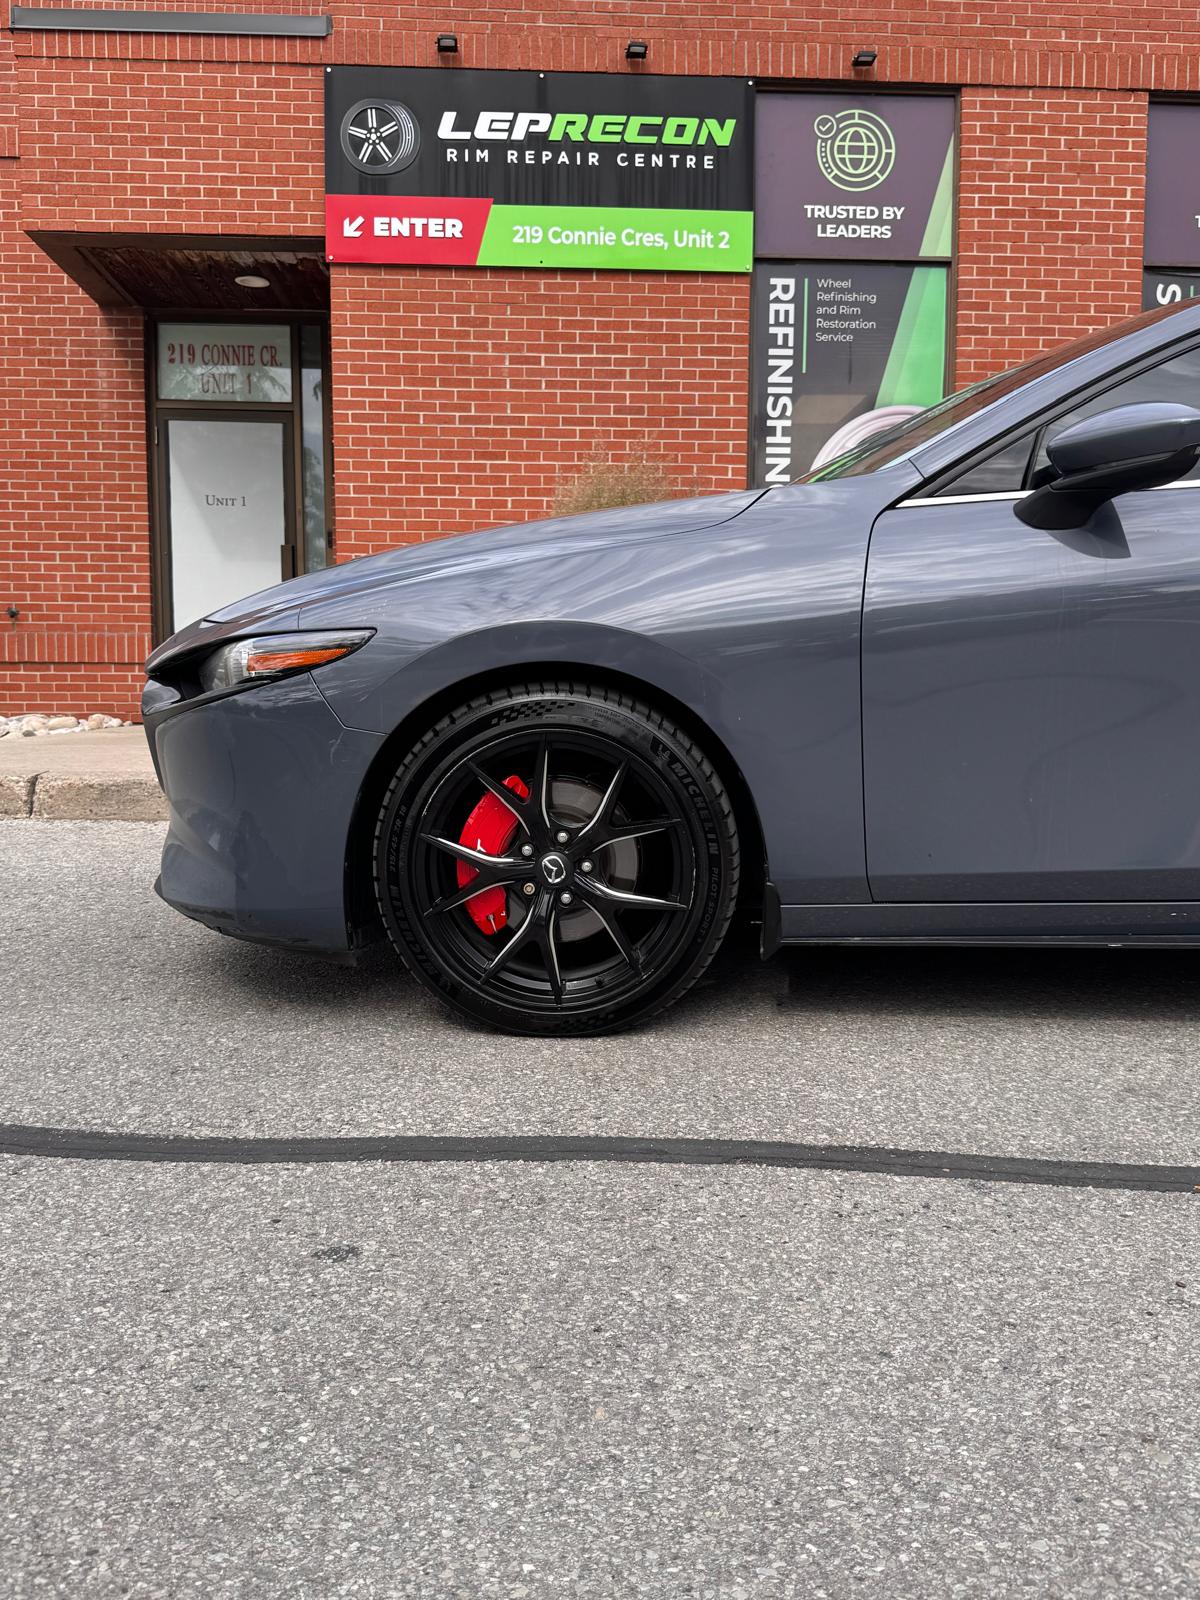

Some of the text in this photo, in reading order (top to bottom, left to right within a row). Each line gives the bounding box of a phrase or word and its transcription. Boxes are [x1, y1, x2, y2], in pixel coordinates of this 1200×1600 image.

[437, 111, 736, 147] LEPRECON
[446, 148, 714, 169] RIM REPAIR CENTRE
[803, 204, 905, 220] TRUSTED BY
[373, 216, 463, 238] ENTER
[817, 223, 892, 239] LEADERS
[512, 225, 730, 250] 219 Connie Cres, Unit 2
[816, 278, 852, 289] Wheel
[816, 291, 877, 304] Refinishing
[816, 305, 861, 315] and Rim
[816, 318, 876, 329] Restoration
[815, 332, 854, 342] Service
[167, 343, 283, 367] 219 CONNIE CR.
[201, 371, 252, 395] UNIT 1
[764, 277, 796, 488] REFINISHIN
[241, 496, 247, 507] 1
[669, 761, 719, 855] MICHELIN
